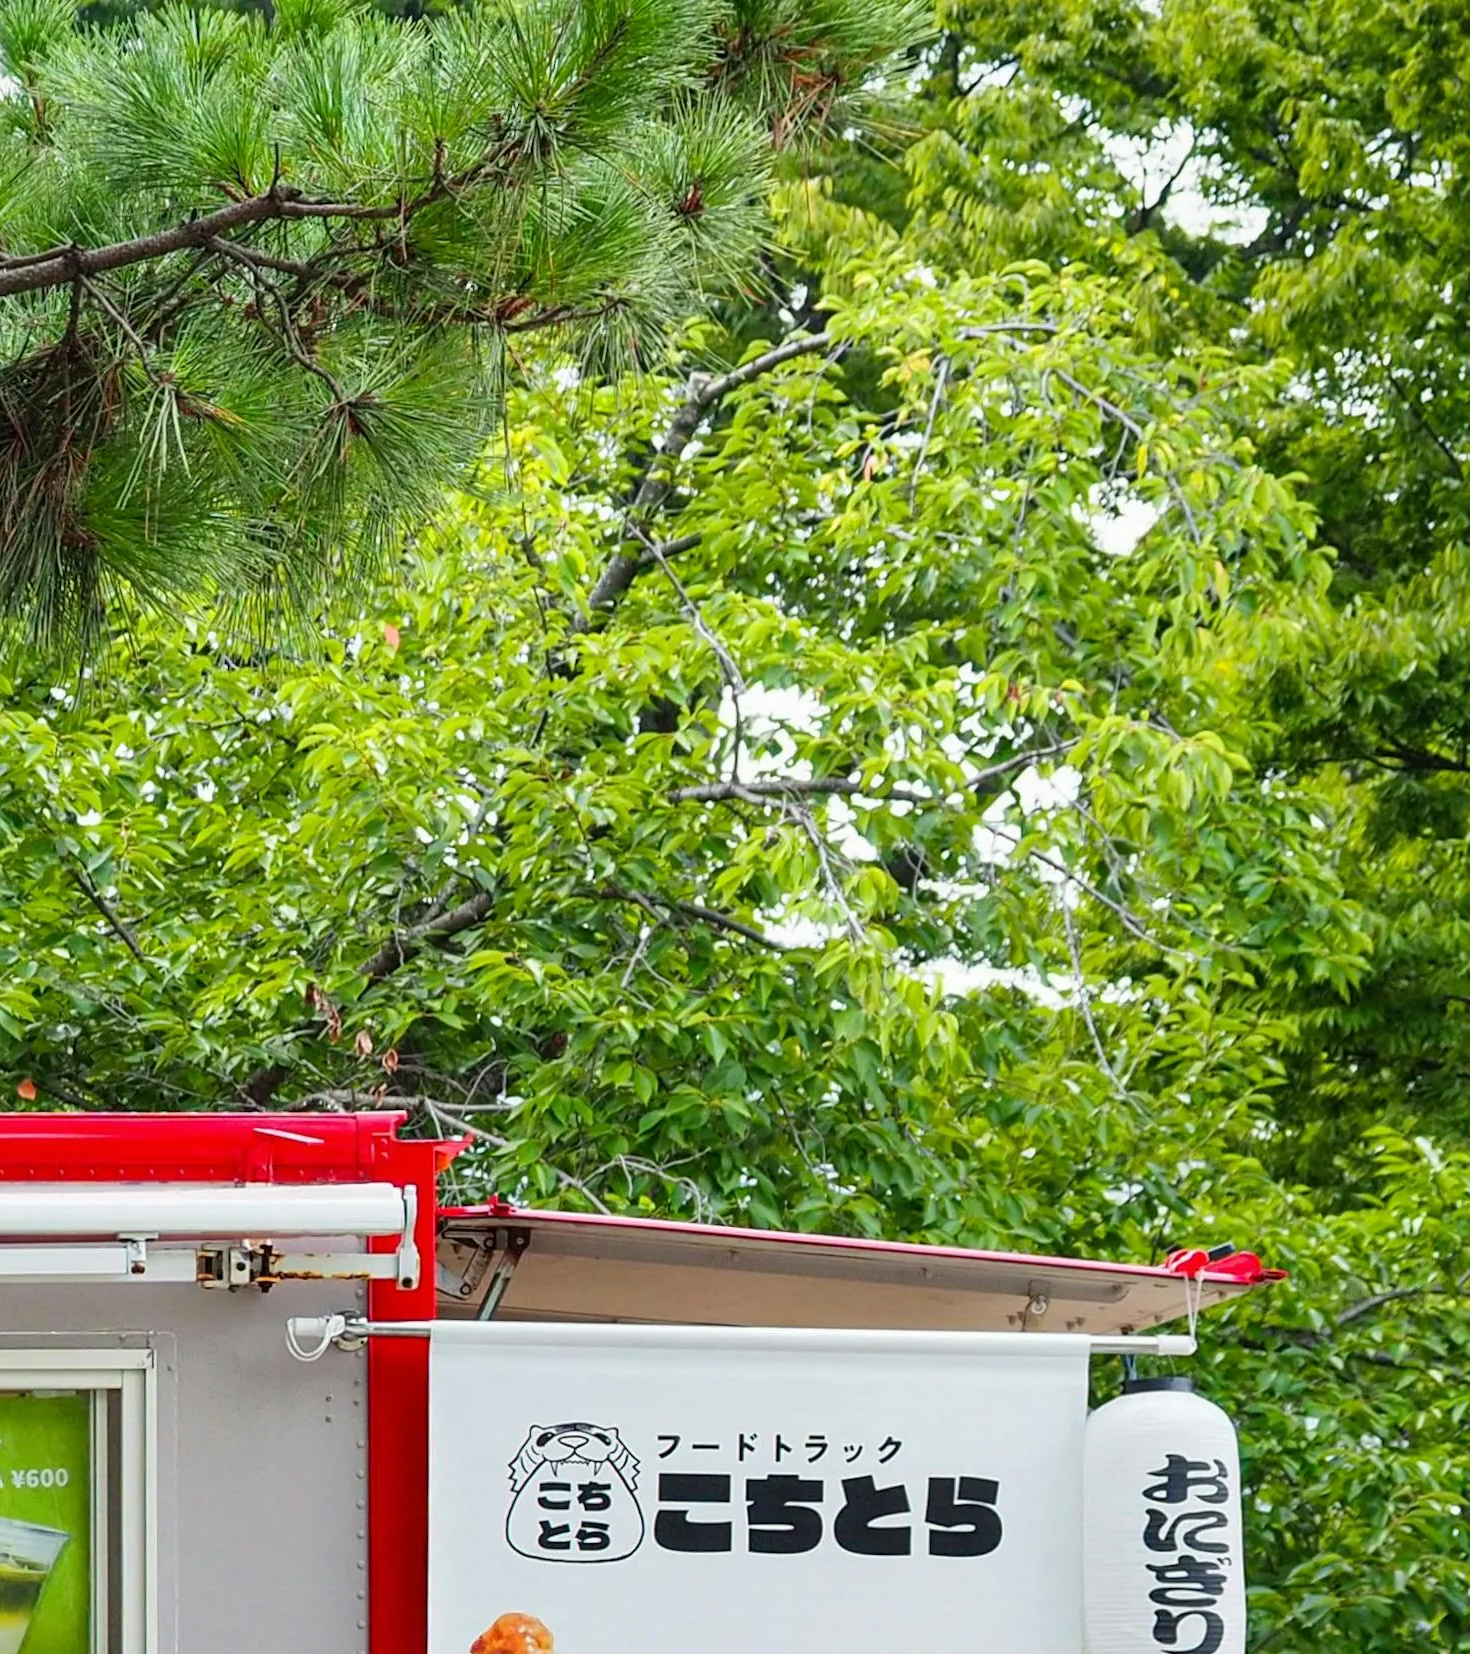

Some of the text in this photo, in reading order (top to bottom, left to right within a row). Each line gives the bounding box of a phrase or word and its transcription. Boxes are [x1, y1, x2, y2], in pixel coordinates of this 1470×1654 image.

[657, 1433, 903, 1464] フードトラック
[11, 1468, 69, 1489] ¥600
[537, 1480, 612, 1512] こち
[653, 1472, 1003, 1558] こちとら
[537, 1519, 611, 1552] とら
